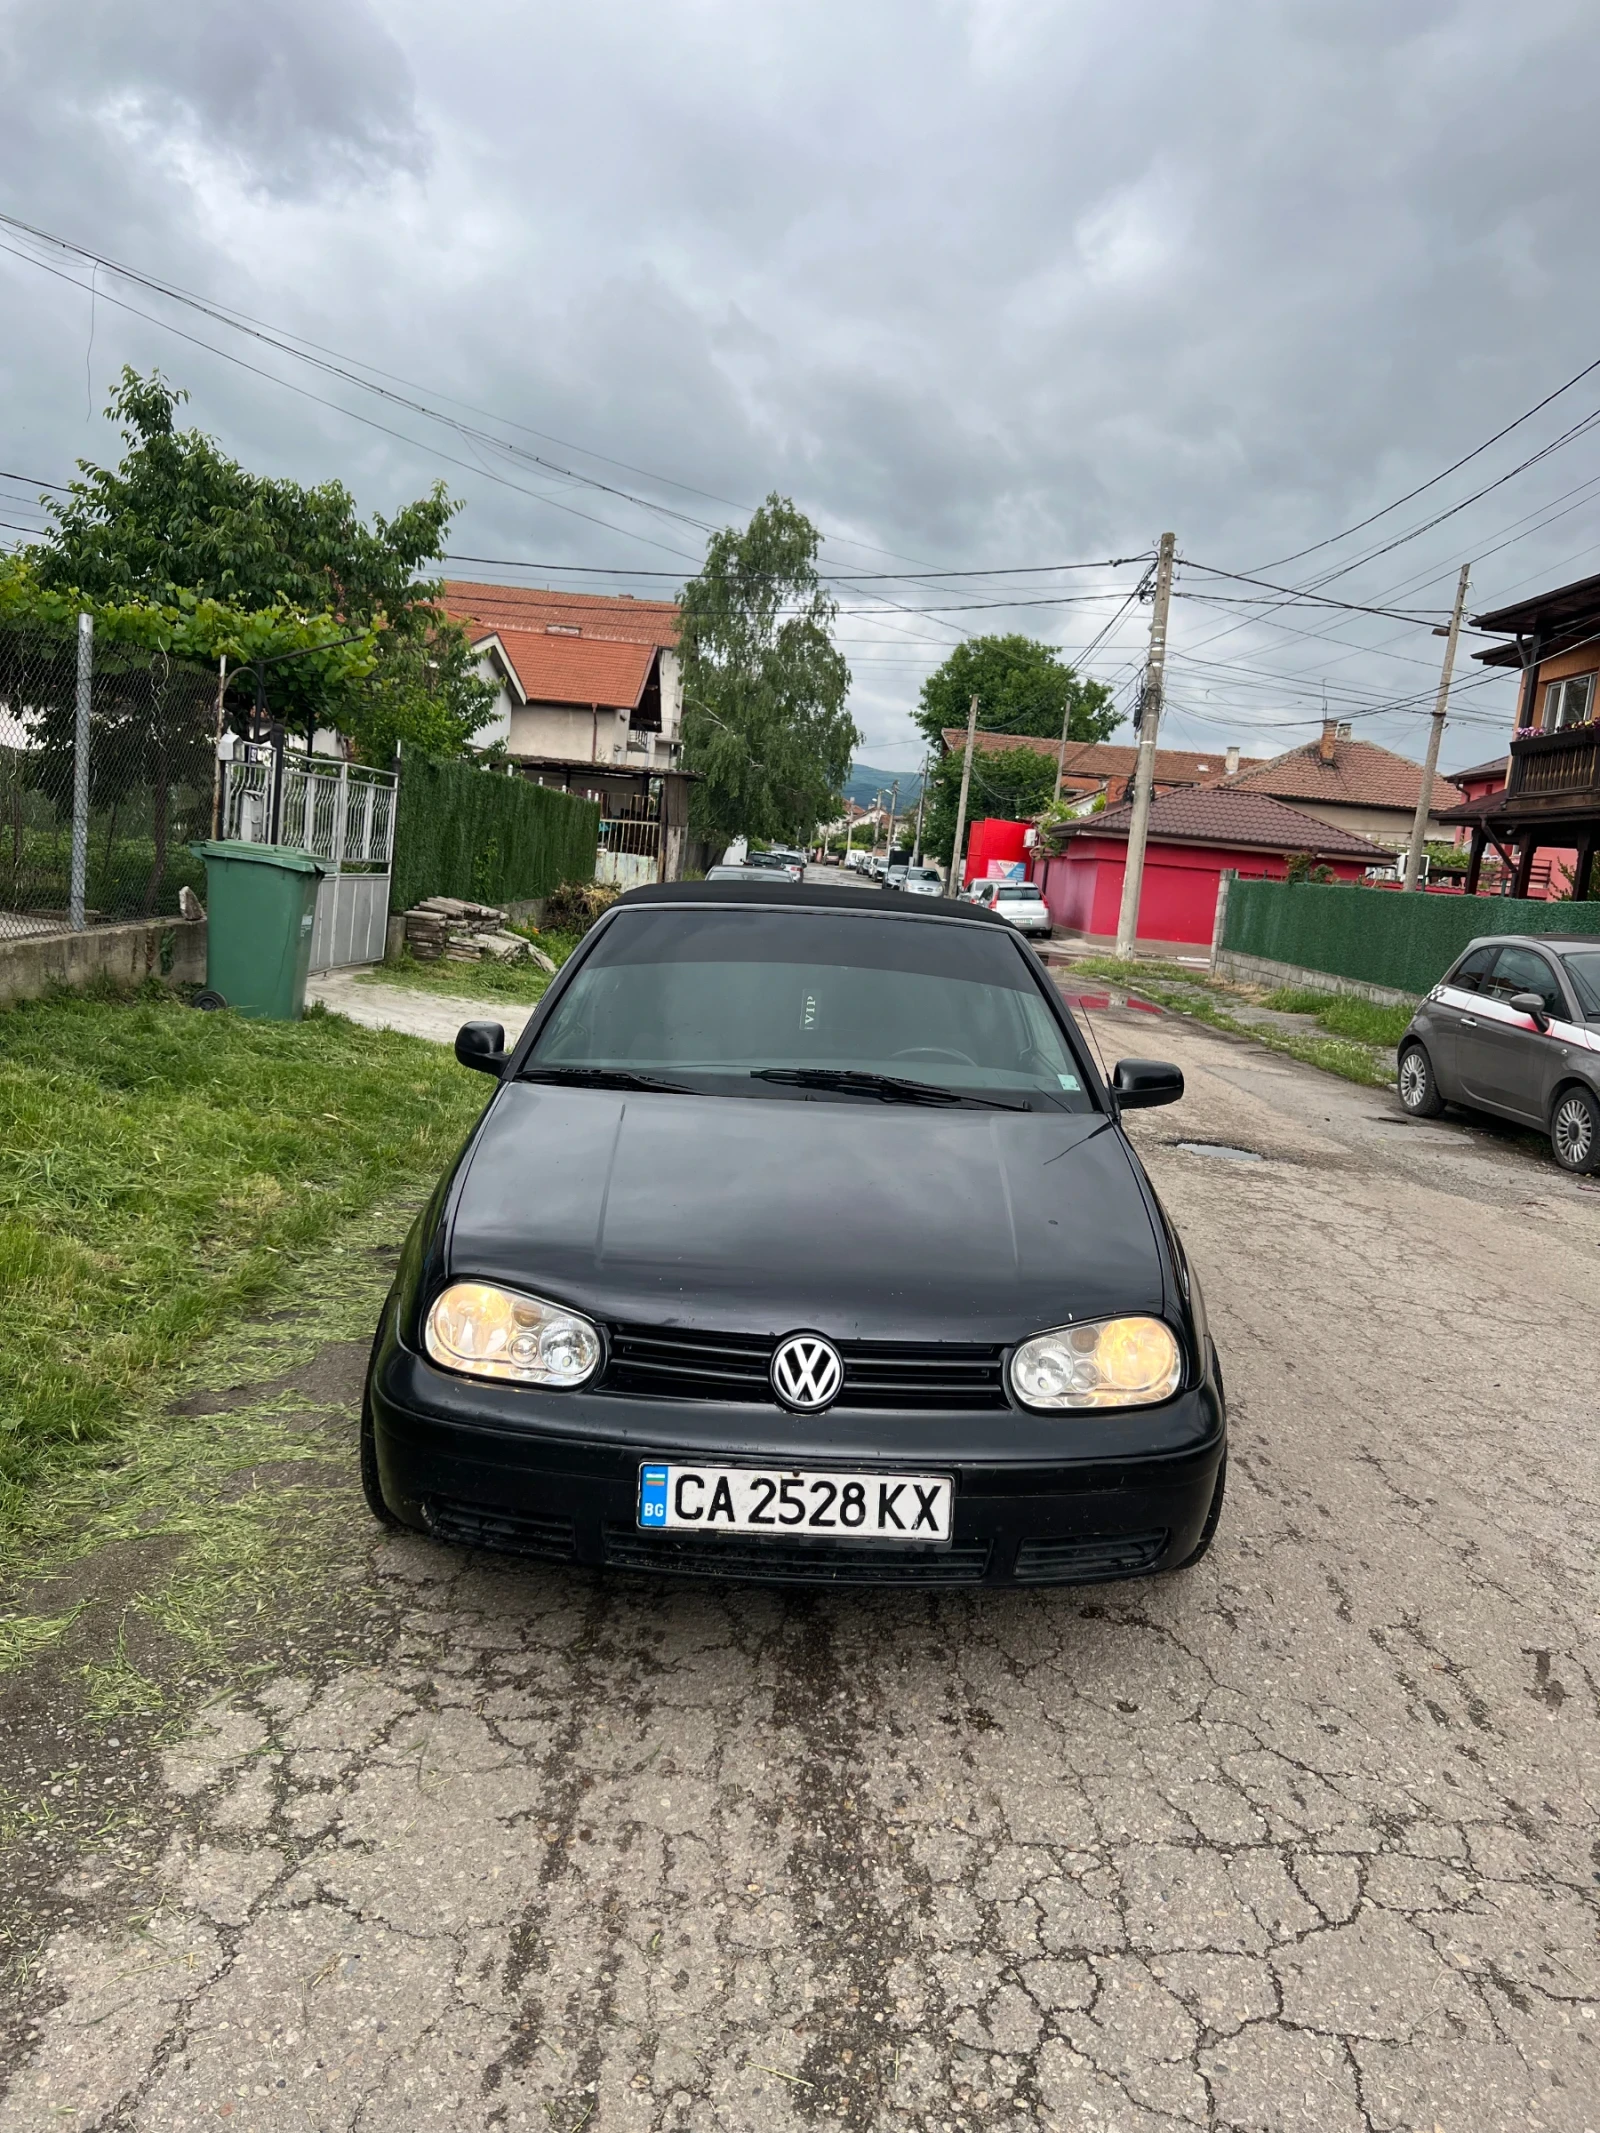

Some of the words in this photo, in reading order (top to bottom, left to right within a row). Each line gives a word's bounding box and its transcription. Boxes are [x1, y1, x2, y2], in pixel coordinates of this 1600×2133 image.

[804, 995, 816, 1025] VIP
[775, 1338, 840, 1406] VW
[644, 1502, 665, 1518] BG
[674, 1473, 736, 1523] CA
[748, 1478, 866, 1528] 2528
[877, 1482, 942, 1532] KX
